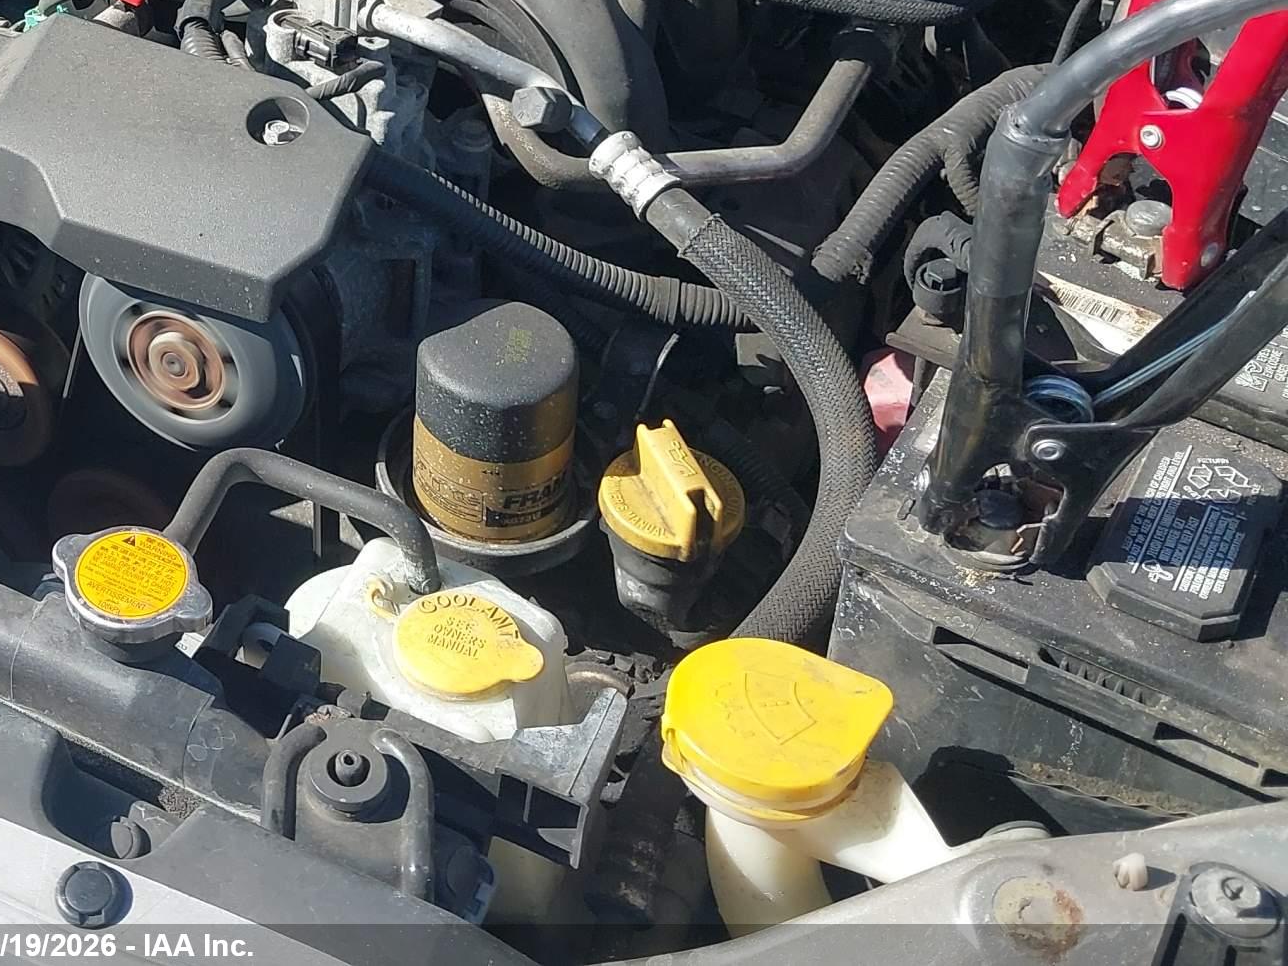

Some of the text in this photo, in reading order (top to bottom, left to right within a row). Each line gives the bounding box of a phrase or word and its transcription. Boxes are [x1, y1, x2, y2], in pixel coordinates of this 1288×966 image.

[87, 580, 146, 611] AVERTISSEMENT
[418, 593, 520, 640] COOLANT
[445, 616, 478, 633] SEE
[426, 633, 480, 660] MANUAL
[433, 623, 487, 649] OWNERS
